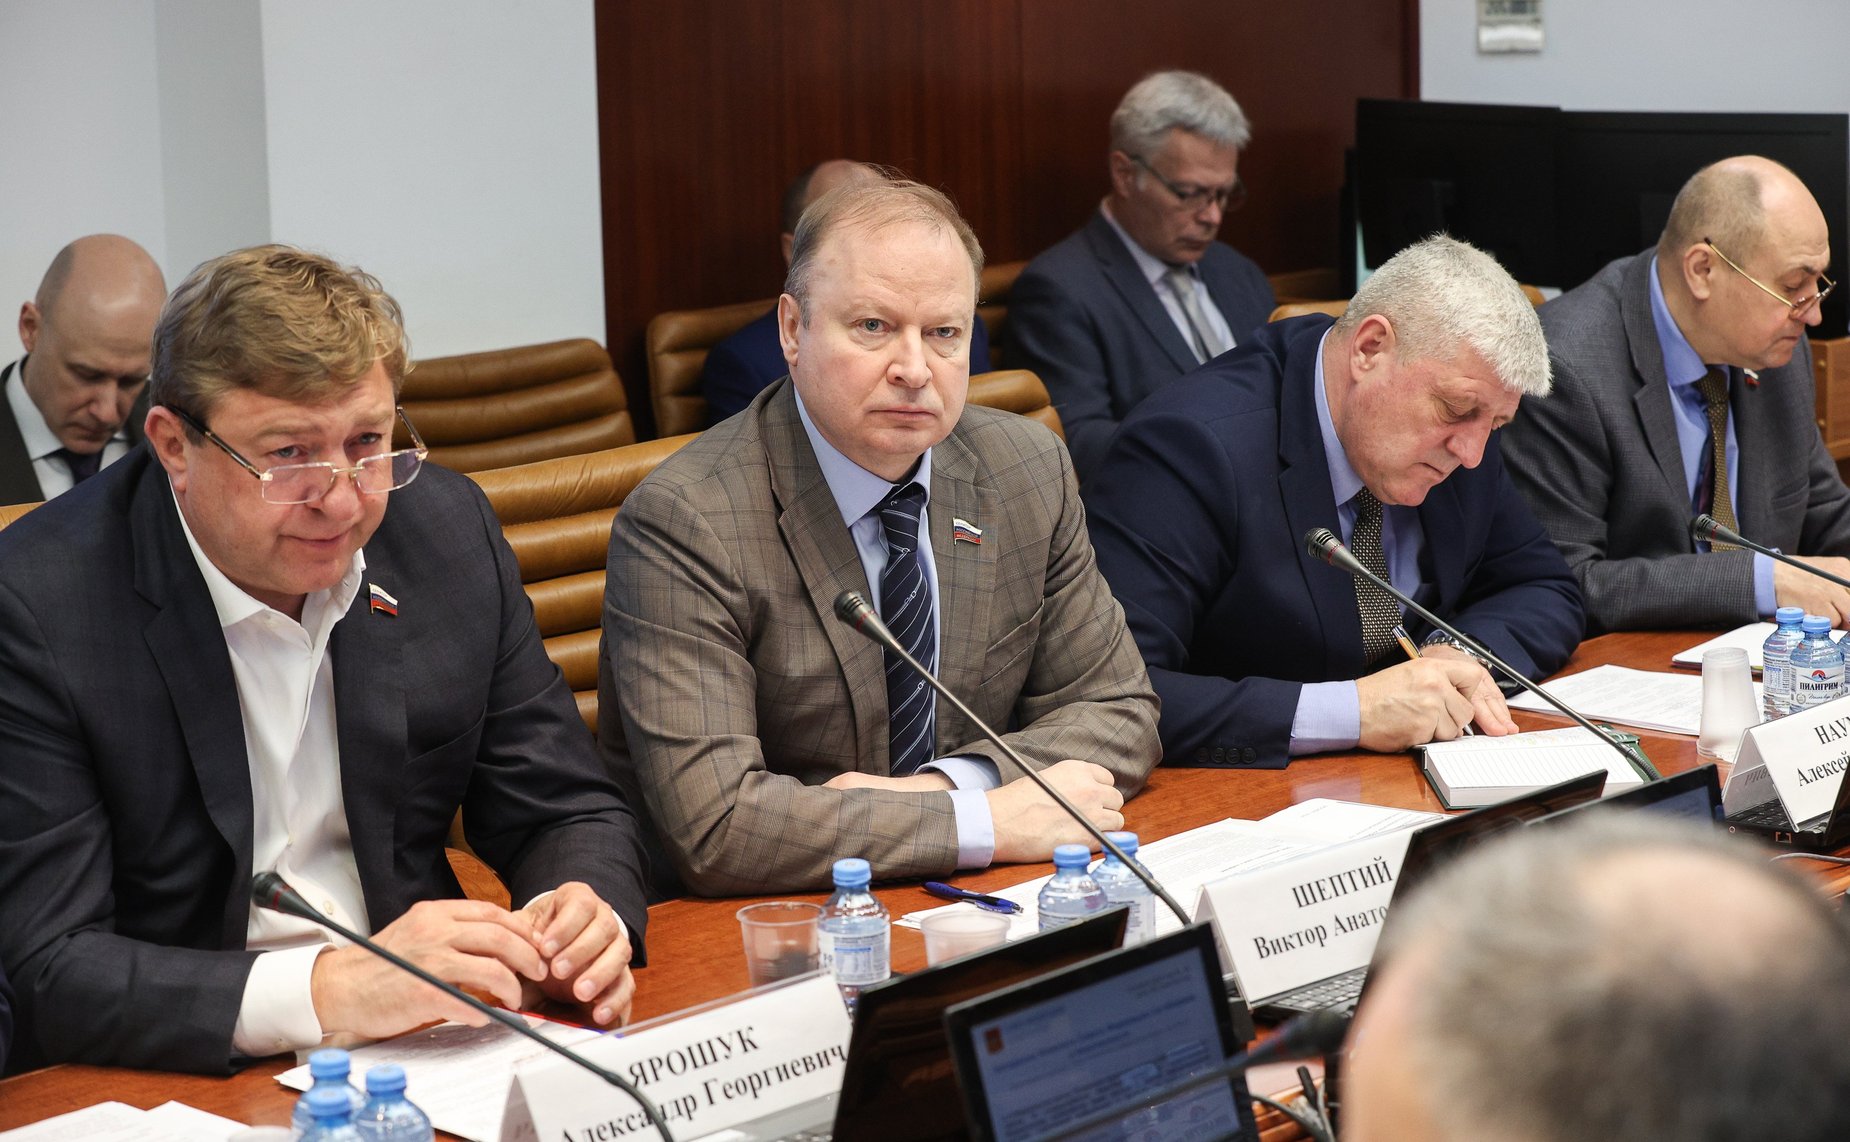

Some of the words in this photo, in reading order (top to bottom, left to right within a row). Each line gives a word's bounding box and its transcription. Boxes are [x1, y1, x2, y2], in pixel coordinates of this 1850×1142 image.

[1799, 682, 1839, 691] ПИЛИГРИМ
[1814, 716, 1850, 745] НАУ
[1291, 856, 1393, 908] ШЕПТИЙ
[1254, 924, 1327, 959] Виктор
[629, 1026, 759, 1088] ЯРОШУК
[703, 1045, 848, 1106] Георгиевич
